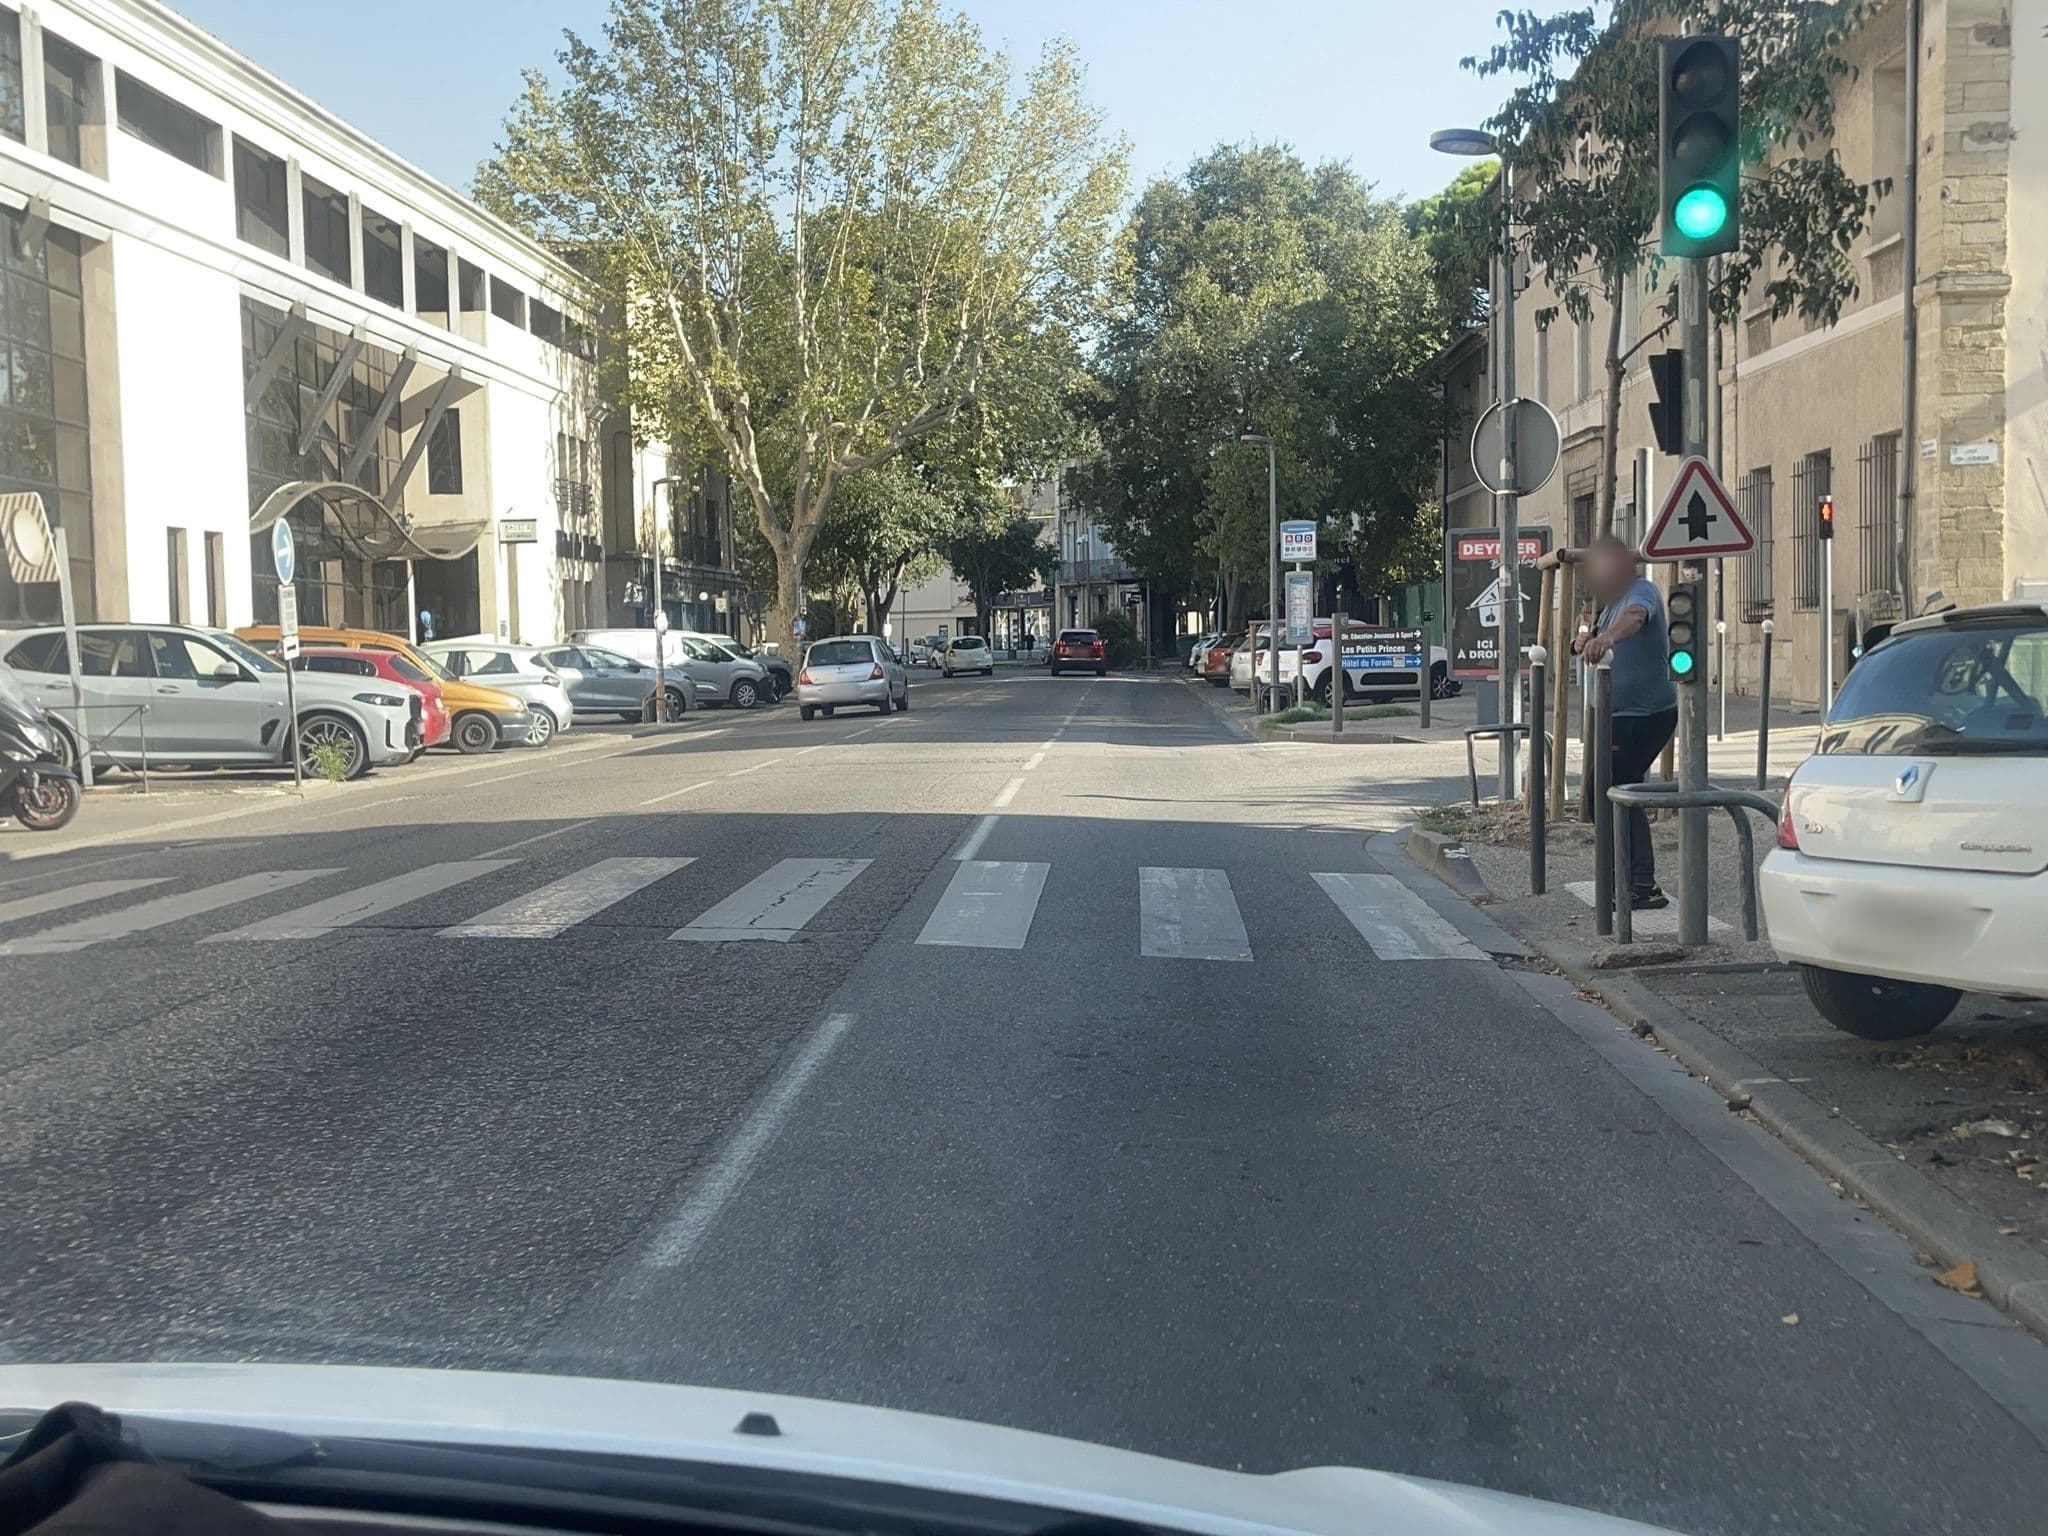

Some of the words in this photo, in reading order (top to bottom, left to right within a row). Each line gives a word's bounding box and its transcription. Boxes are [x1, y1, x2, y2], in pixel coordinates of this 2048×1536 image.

[1463, 542, 1537, 555] DEYER
[1341, 645, 1354, 654] Les
[1356, 645, 1377, 654] Petits
[1378, 644, 1406, 653] Princes
[1477, 640, 1493, 649] ICI
[1469, 650, 1500, 659] DROI
[1341, 658, 1359, 667] Hôtel
[1370, 658, 1393, 667] Forum
